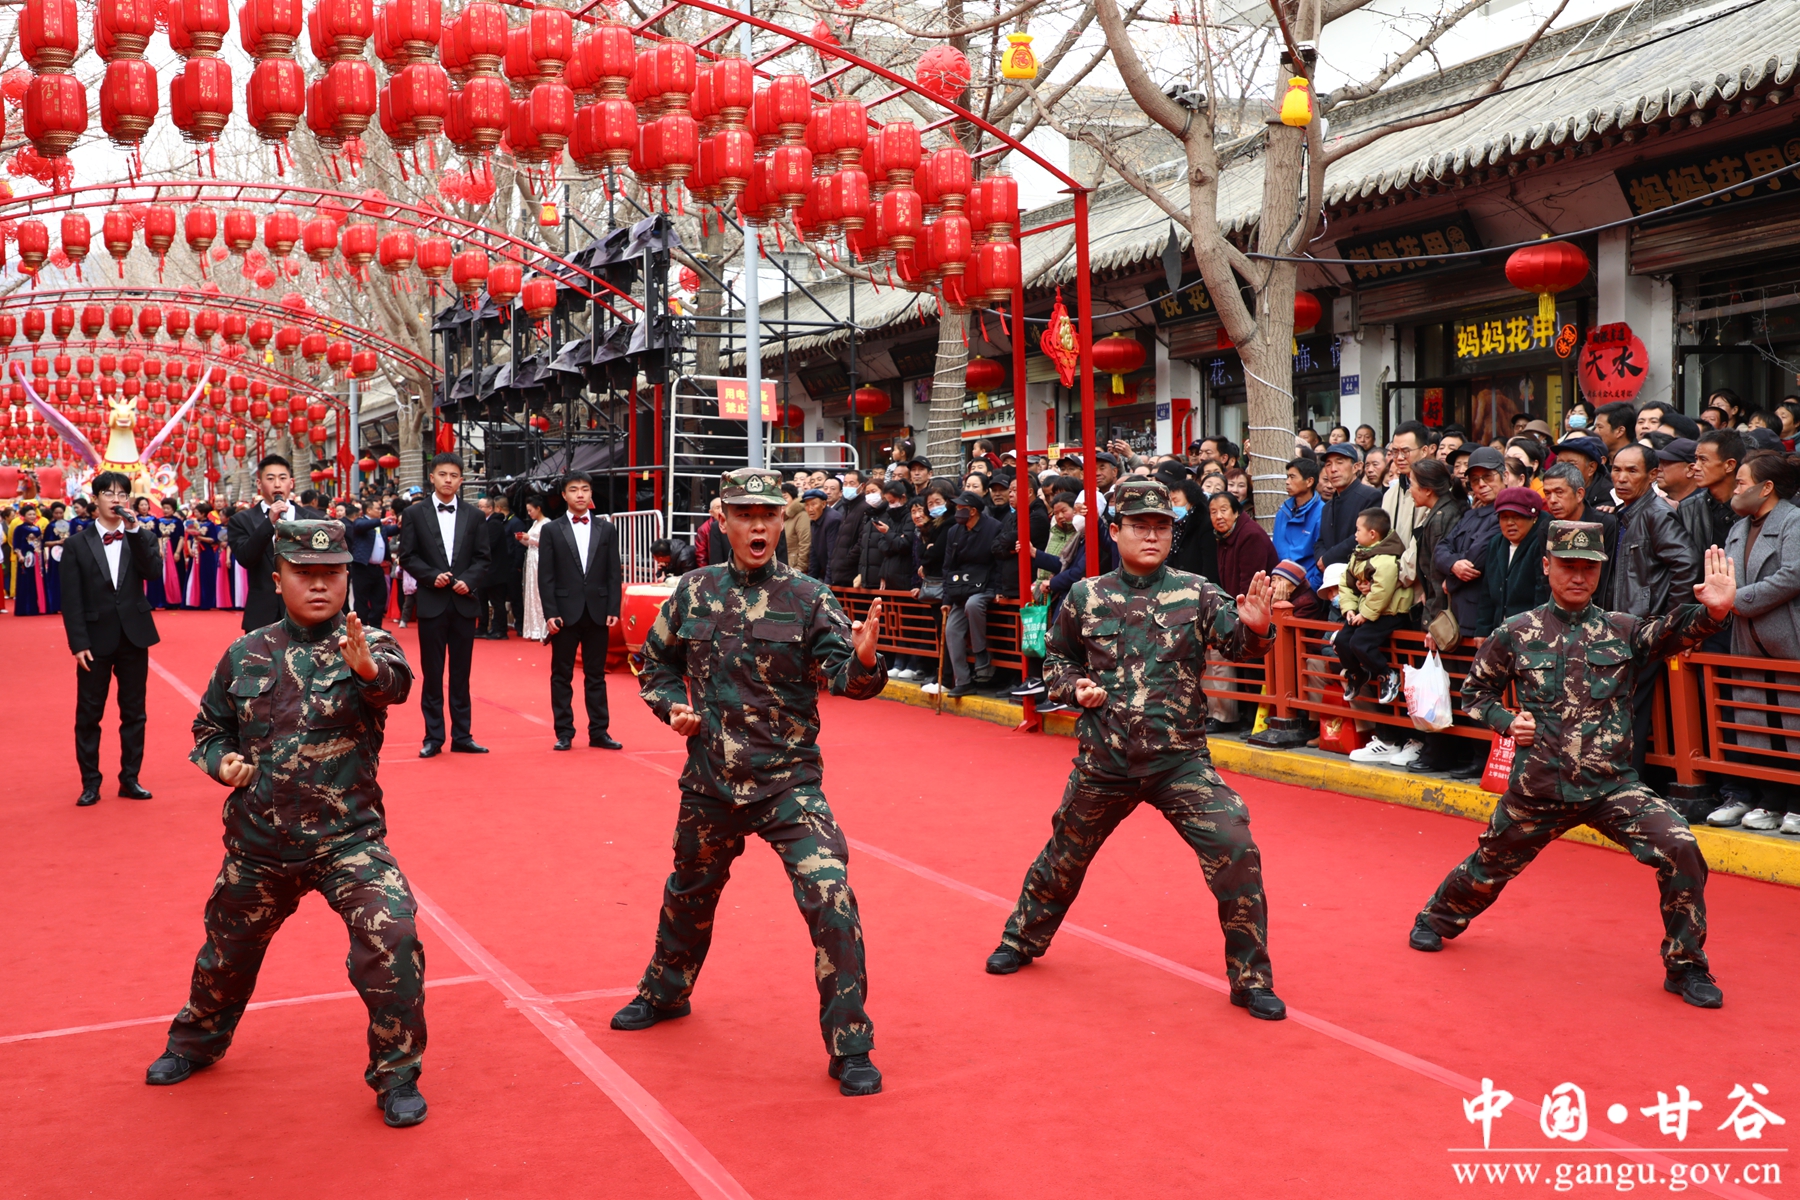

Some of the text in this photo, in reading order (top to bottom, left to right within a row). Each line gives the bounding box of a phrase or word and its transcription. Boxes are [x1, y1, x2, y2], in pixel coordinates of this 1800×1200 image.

[1630, 145, 1787, 214] 妈妈花甲
[1350, 230, 1449, 280] 妈妈花甲
[1457, 315, 1555, 358] 妈妈花甲
[1585, 345, 1644, 381] 天水
[725, 388, 768, 402] 用电备
[725, 401, 770, 416] 禁止爬
[1426, 401, 1441, 427] 好
